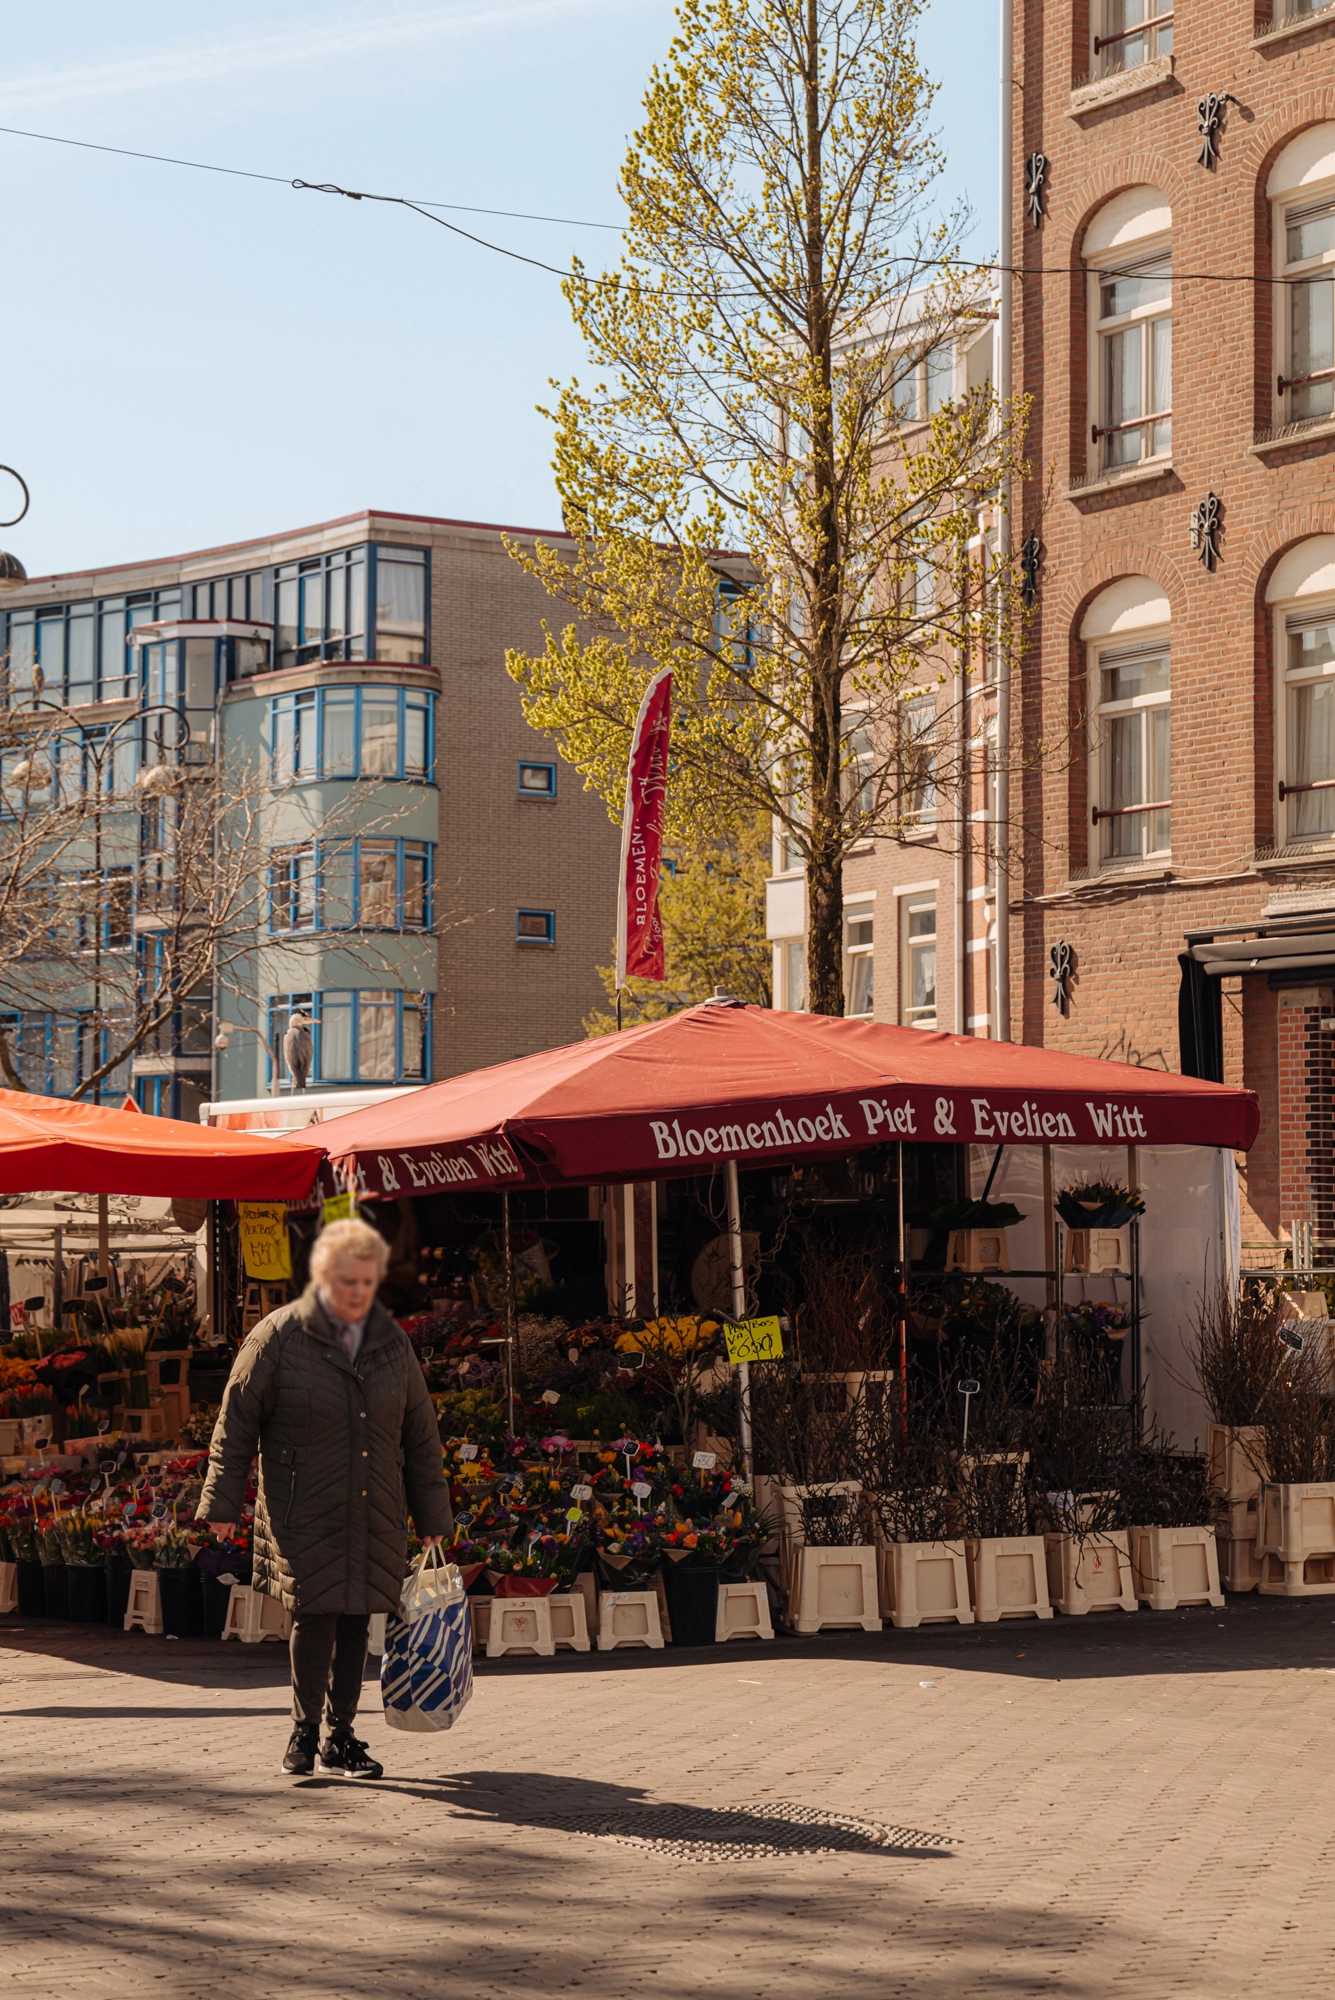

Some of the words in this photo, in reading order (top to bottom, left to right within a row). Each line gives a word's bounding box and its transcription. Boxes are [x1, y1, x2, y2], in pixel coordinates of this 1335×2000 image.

[649, 1103, 851, 1159] Bloemenhoek
[858, 1099, 917, 1135] Piet
[933, 1097, 957, 1135] &
[971, 1098, 1077, 1138] Evelien
[1085, 1102, 1148, 1138] Witt
[377, 1155, 401, 1192] &
[399, 1151, 478, 1188] Evelien
[466, 1142, 518, 1177] Witt
